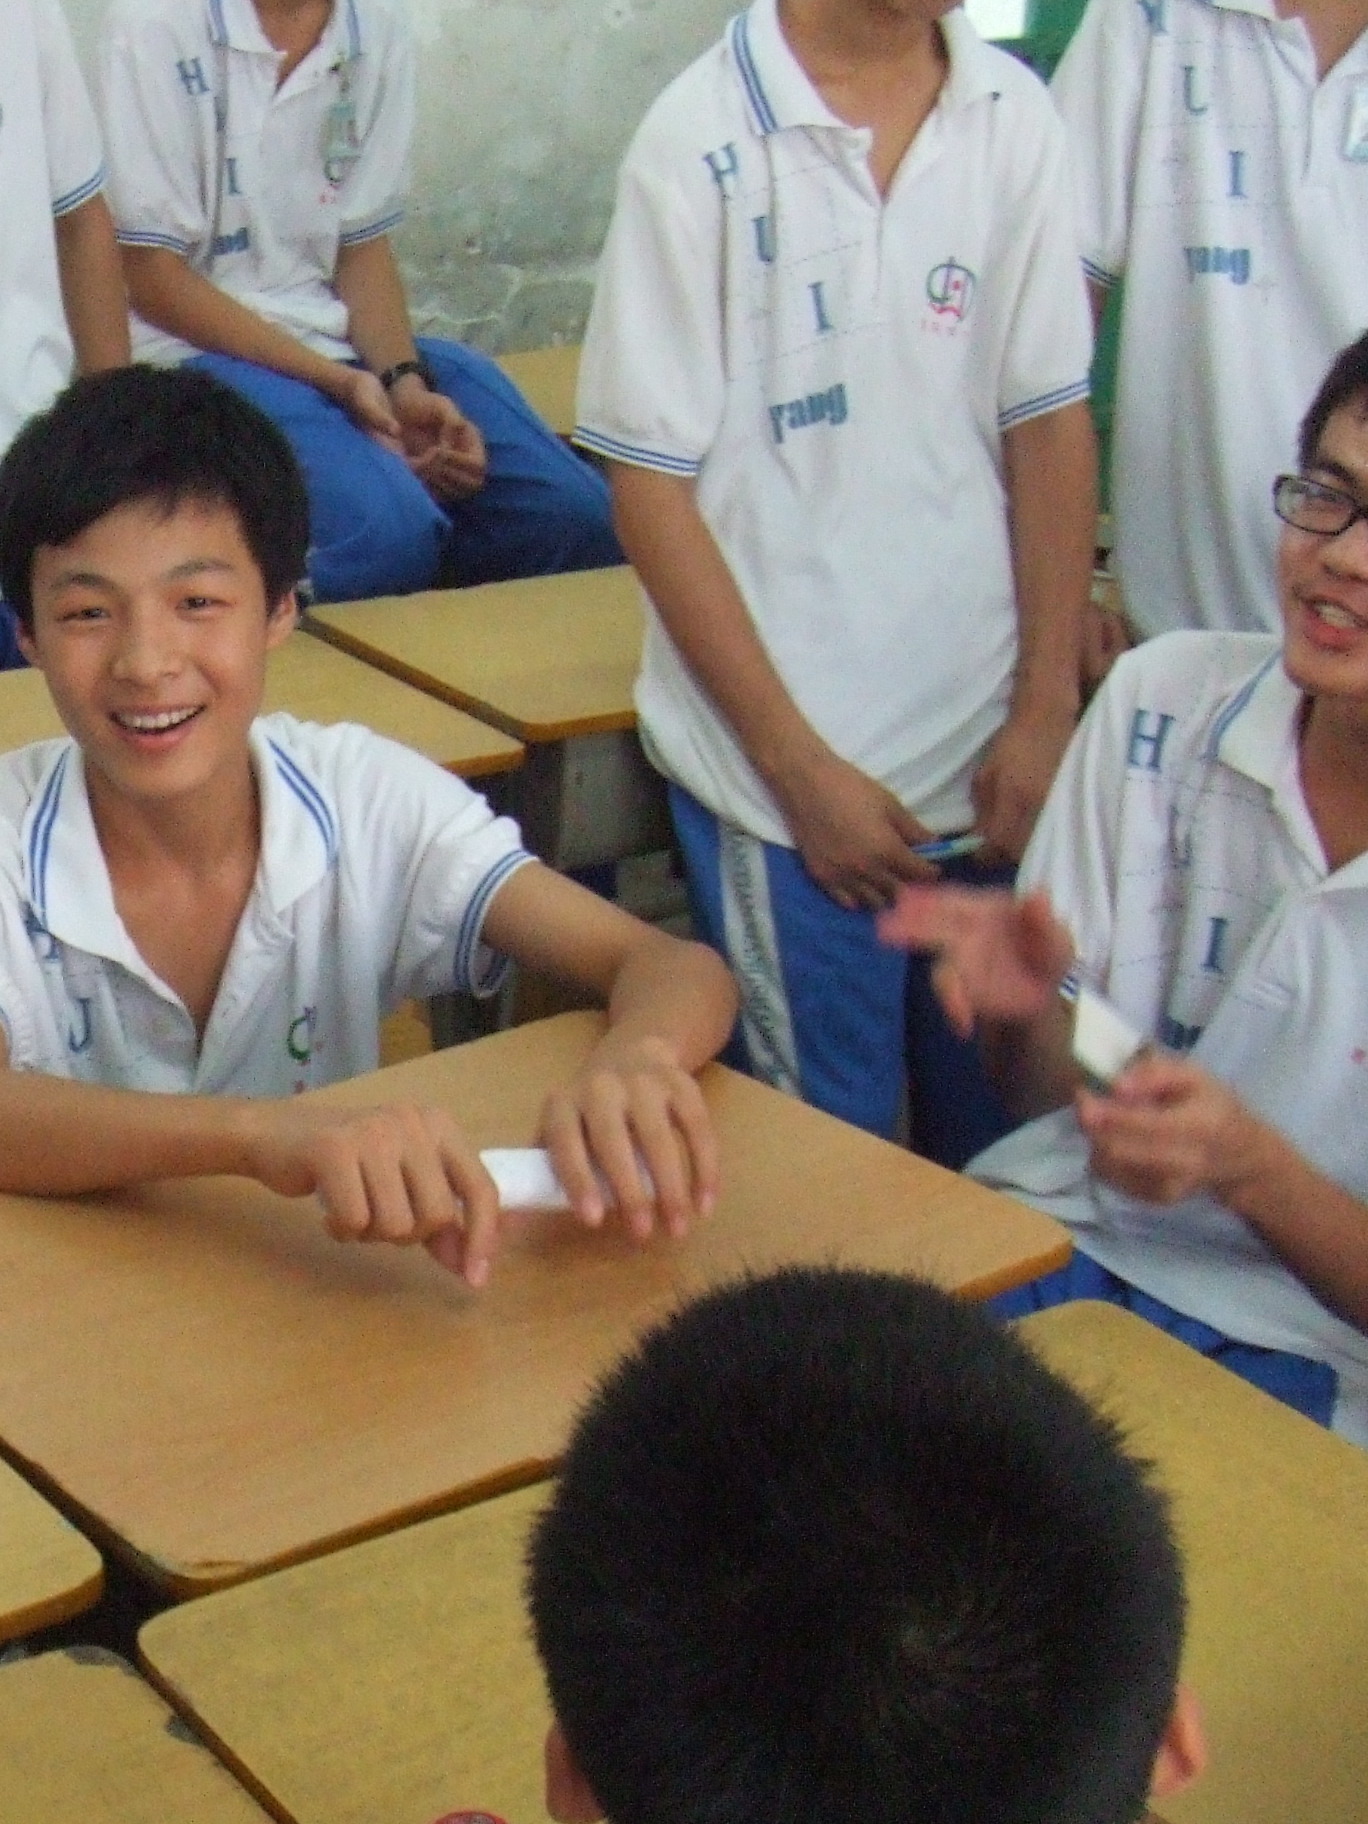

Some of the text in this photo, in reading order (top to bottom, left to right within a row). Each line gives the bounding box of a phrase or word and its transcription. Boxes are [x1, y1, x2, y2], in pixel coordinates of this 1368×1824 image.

[1226, 150, 1248, 199] I
[808, 281, 833, 333] I
[1127, 709, 1175, 774] H
[1200, 916, 1228, 974] I
